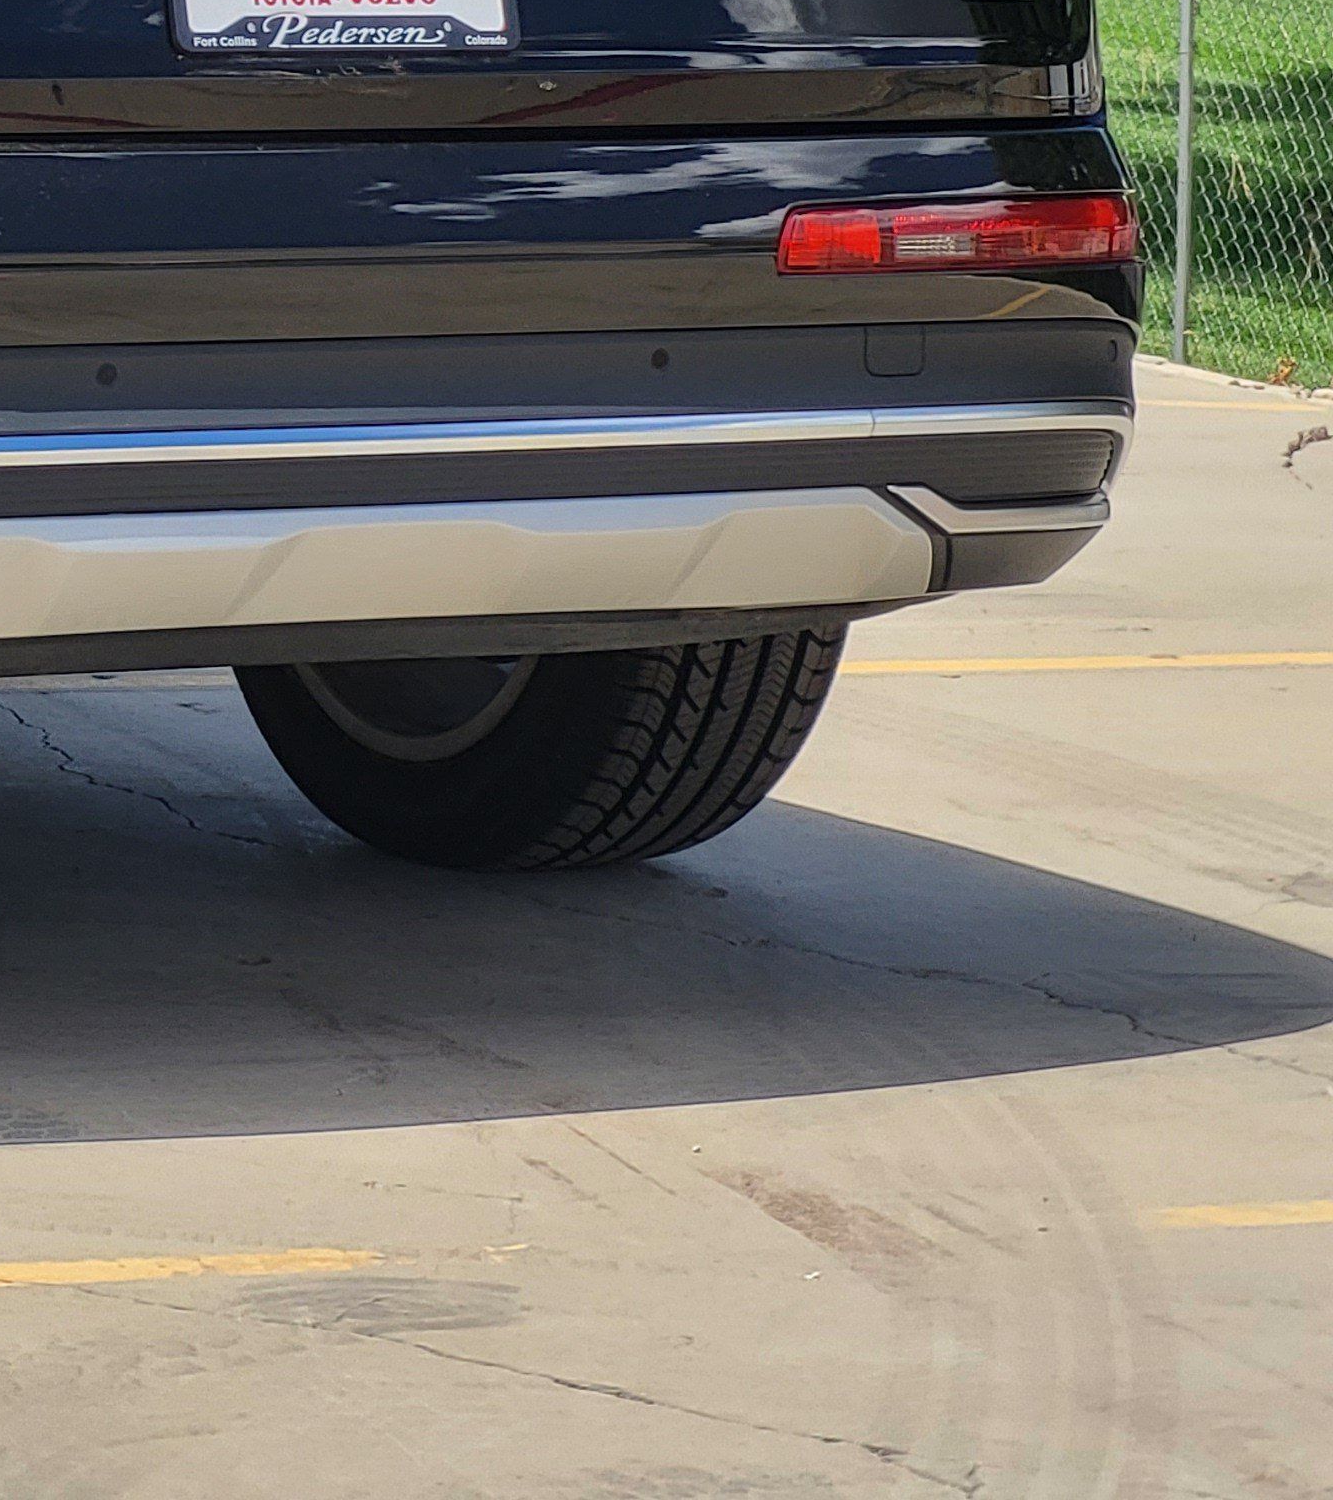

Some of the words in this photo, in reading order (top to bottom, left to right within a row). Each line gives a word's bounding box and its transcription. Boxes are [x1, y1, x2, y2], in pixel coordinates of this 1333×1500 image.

[262, 13, 445, 49] Pedersen
[193, 36, 218, 48] Fort
[219, 36, 258, 48] Collins
[464, 34, 508, 46] Colorado
